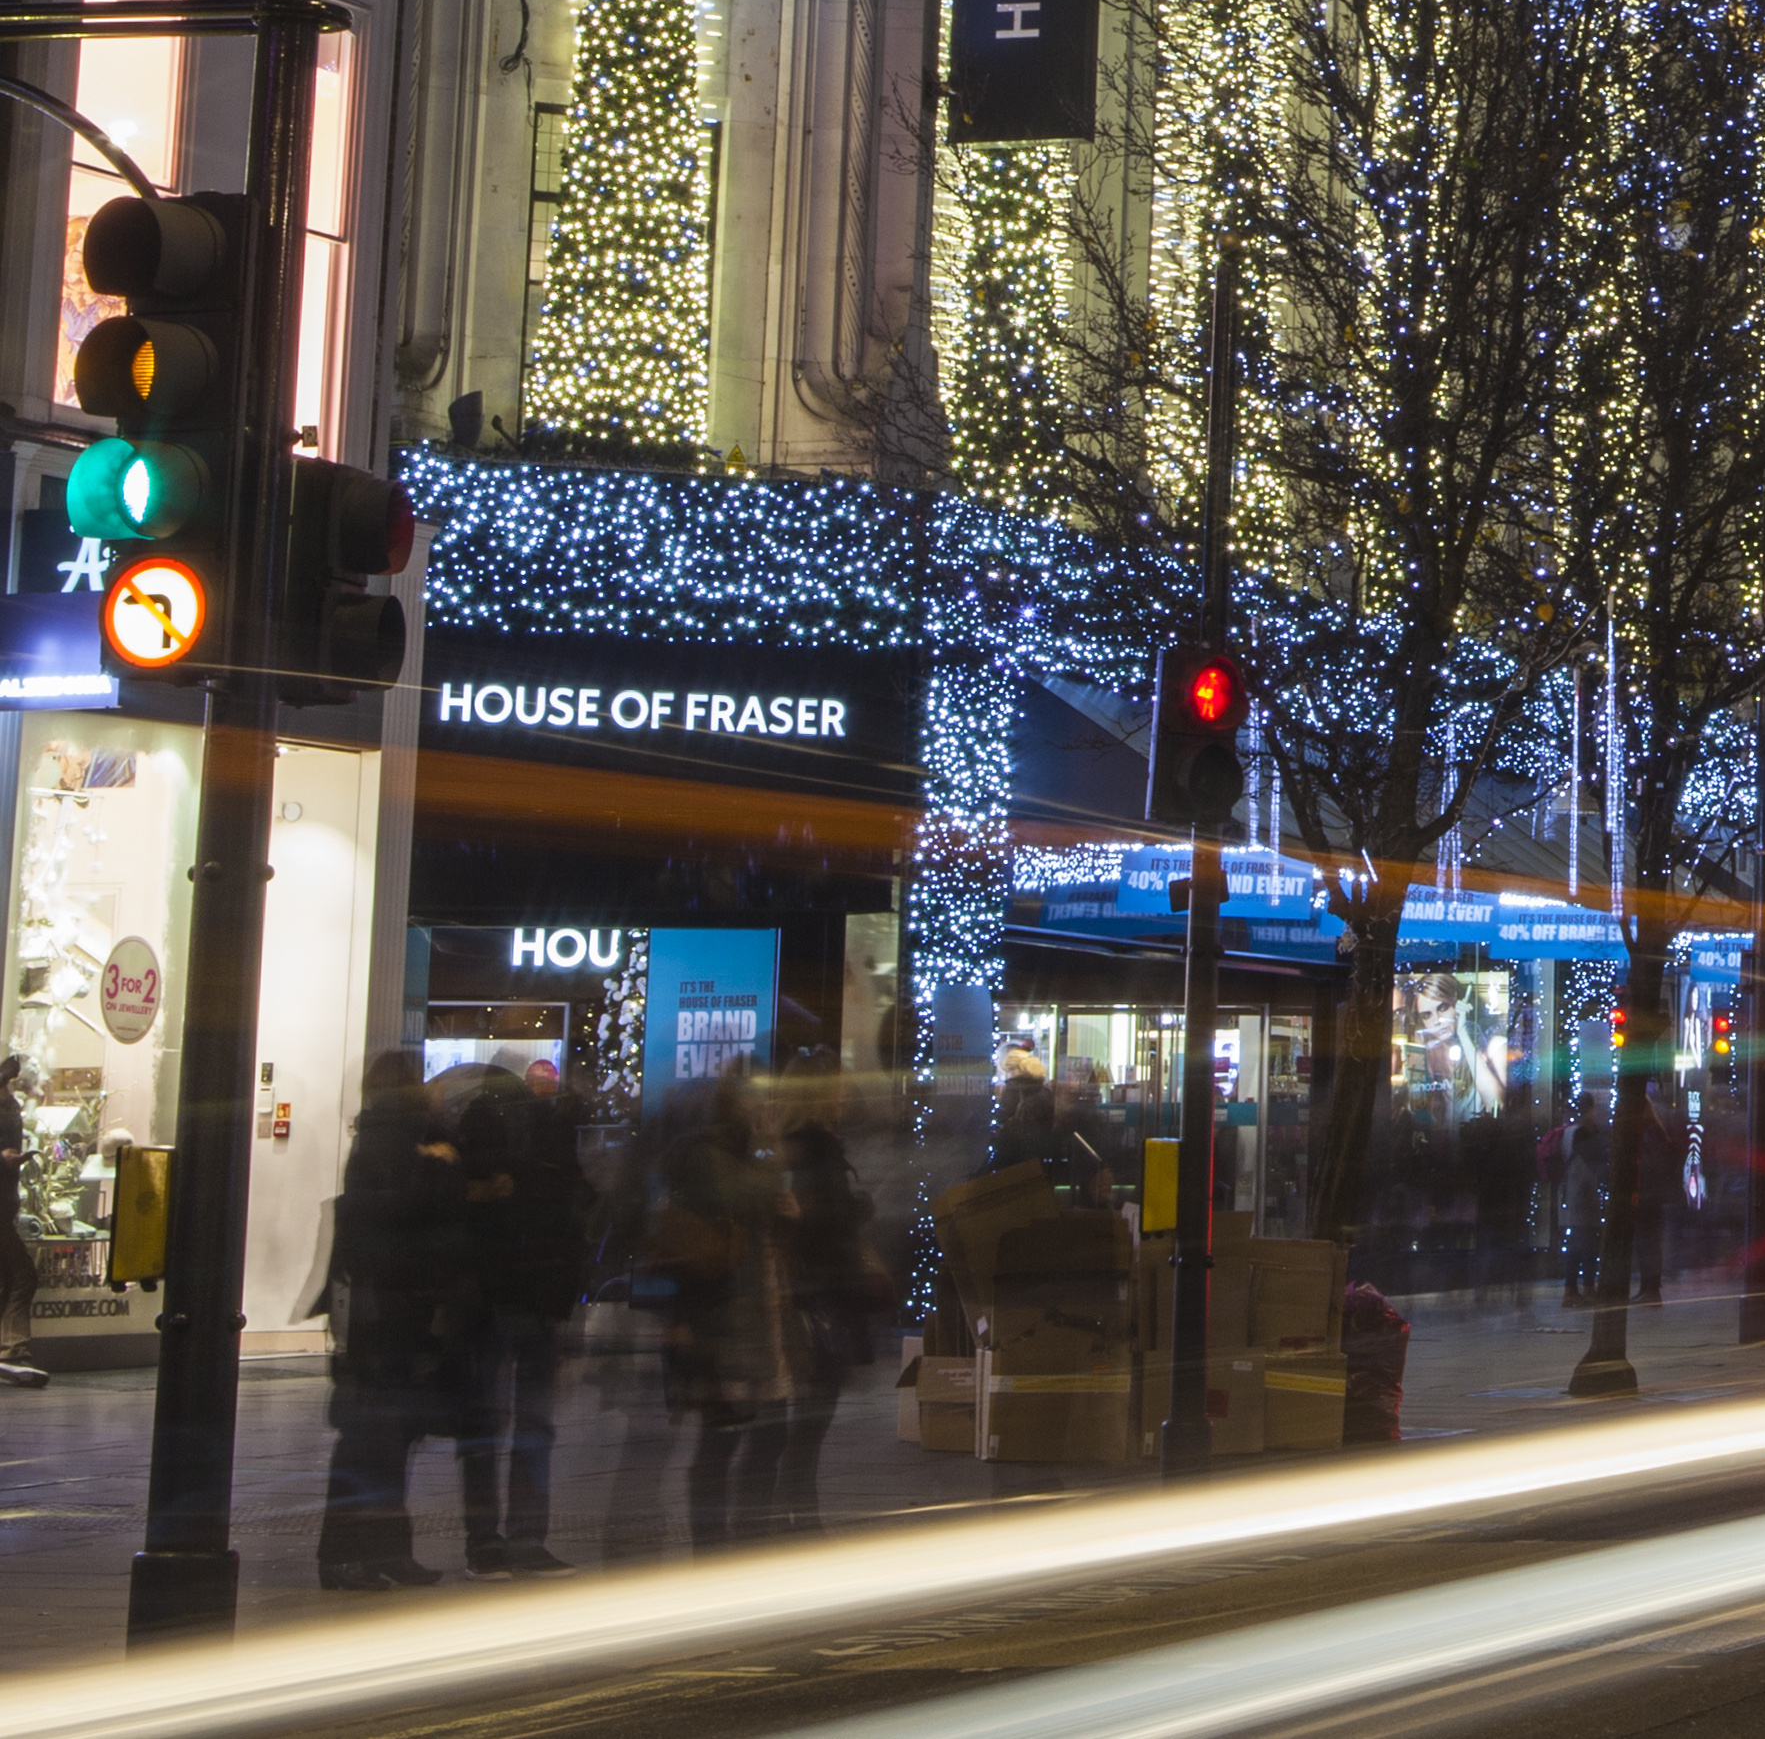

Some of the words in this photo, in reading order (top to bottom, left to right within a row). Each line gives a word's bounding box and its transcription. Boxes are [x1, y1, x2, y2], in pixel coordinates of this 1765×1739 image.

[439, 682, 601, 728] HOUSE
[610, 689, 675, 730] OF
[684, 692, 847, 737] FRASER
[1150, 858, 1169, 870] IT'S
[1173, 859, 1191, 871] THE
[1231, 862, 1243, 874] OF
[1245, 862, 1285, 875] FRASR
[1128, 870, 1164, 891] 40%
[1256, 876, 1307, 896] EVENT
[1447, 903, 1494, 923] EVENT
[1519, 913, 1535, 924] IT'S
[1537, 913, 1554, 924] THE
[1555, 913, 1585, 925] HOUSE
[1586, 913, 1598, 924] OF
[1499, 923, 1530, 941] 40%
[1532, 924, 1557, 941] OFF
[1558, 924, 1606, 941] BRAND
[1698, 951, 1726, 967] 40%
[105, 963, 120, 1000] 3
[120, 977, 143, 994] FOR
[142, 968, 157, 1004] 2
[680, 981, 697, 994] IT'S
[698, 980, 715, 993] THE
[105, 1001, 117, 1012] ON
[119, 1003, 153, 1016] JEWELLERY
[679, 996, 709, 1009] HOUSE
[710, 996, 723, 1008] OF
[723, 994, 758, 1008] FRASER
[677, 1009, 757, 1042] BRAND
[675, 1042, 756, 1079] EVENT
